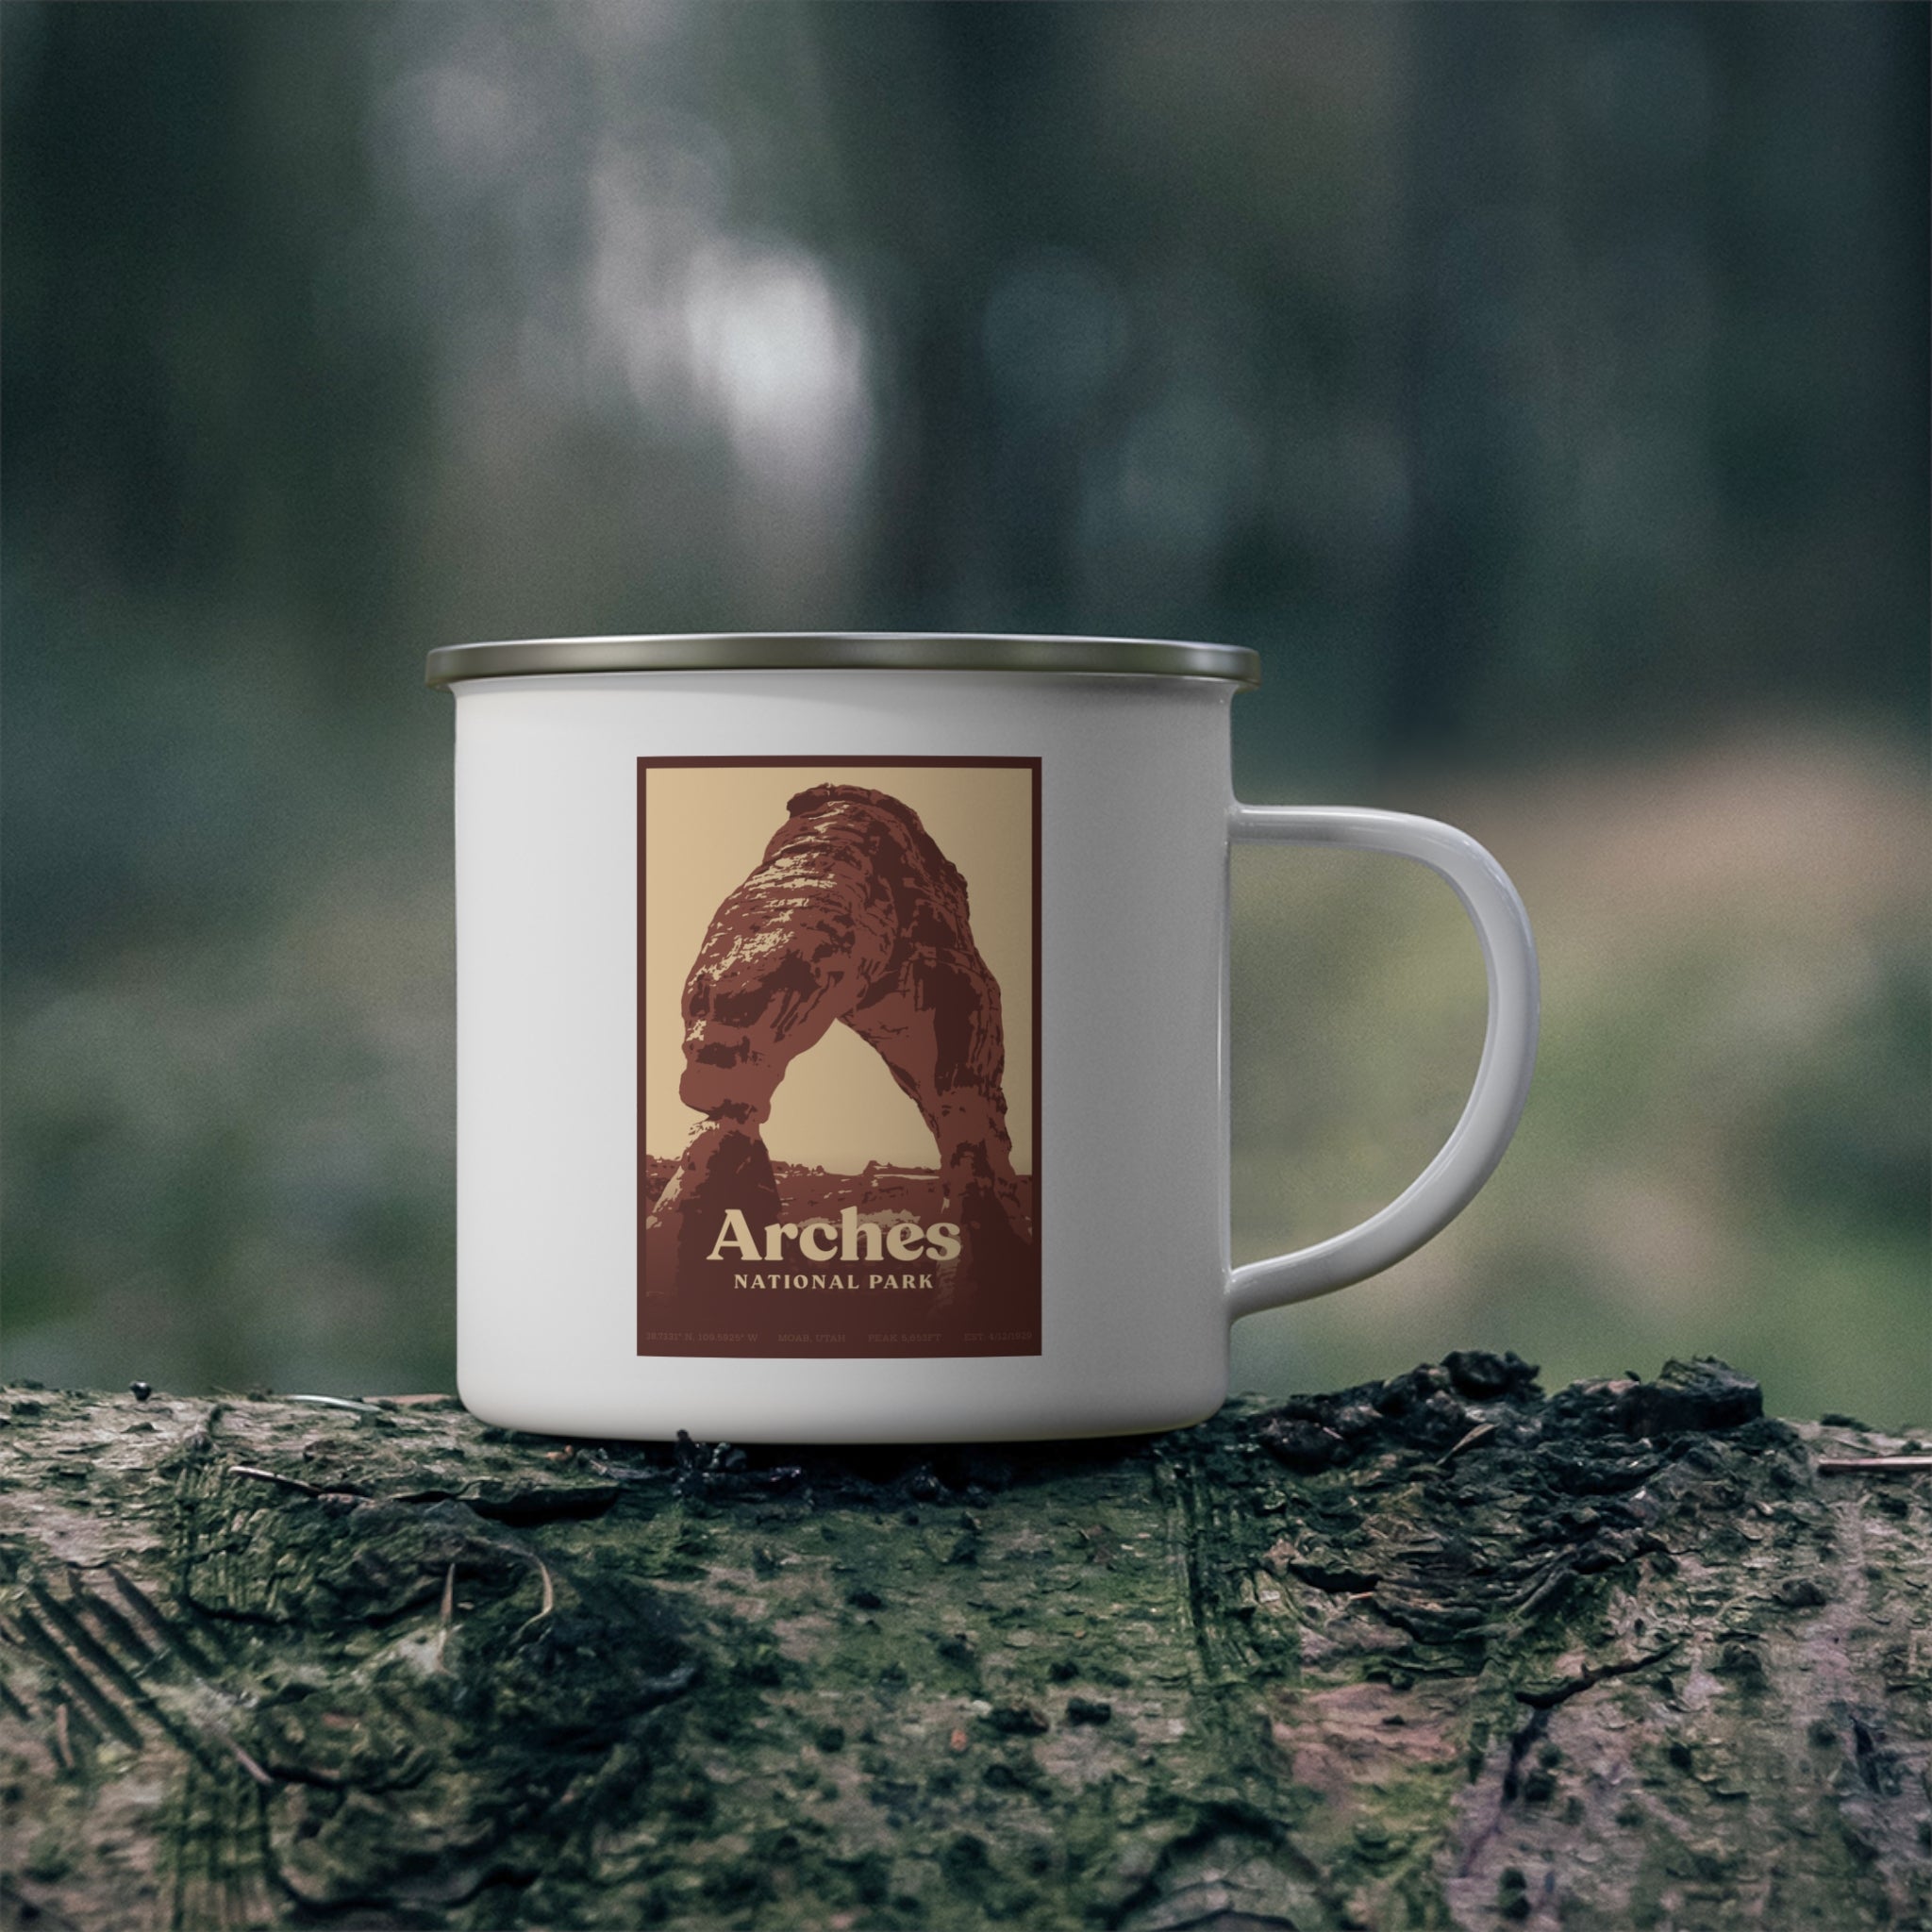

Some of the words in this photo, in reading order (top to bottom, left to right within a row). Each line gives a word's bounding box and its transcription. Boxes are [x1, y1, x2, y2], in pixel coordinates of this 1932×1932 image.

[706, 1206, 961, 1261] Arches
[734, 1274, 859, 1290] NATIONAL
[869, 1274, 934, 1290] PARK
[747, 1333, 758, 1343] W
[777, 1334, 813, 1344] MOAB,
[815, 1334, 846, 1343] UTAH
[867, 1334, 898, 1343] PEAK
